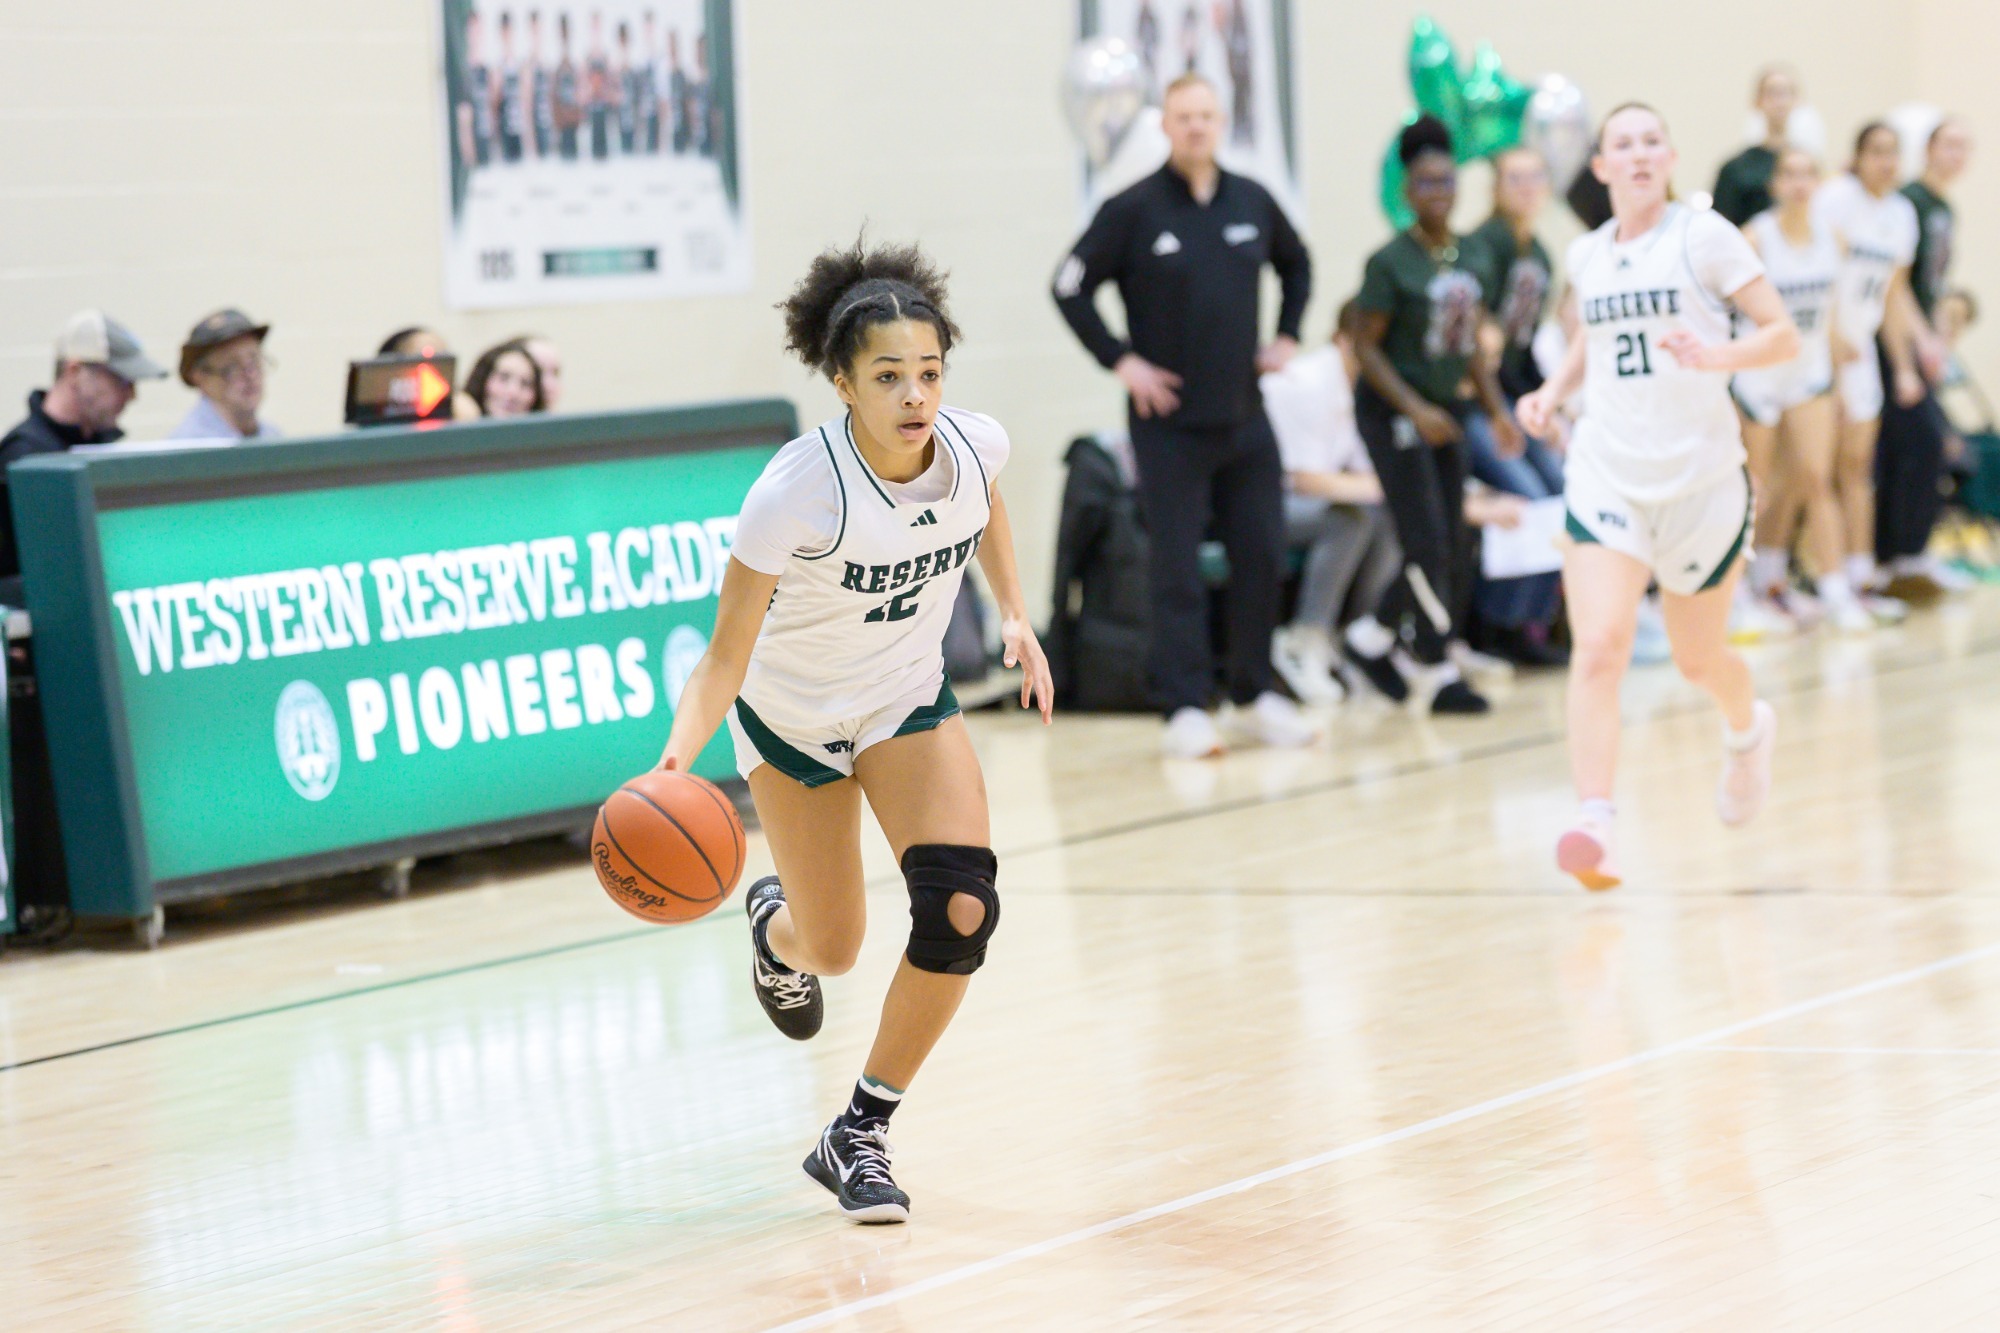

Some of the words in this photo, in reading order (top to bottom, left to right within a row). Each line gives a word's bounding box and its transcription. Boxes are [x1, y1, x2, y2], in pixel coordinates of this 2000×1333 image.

[1615, 331, 1653, 376] 21
[113, 562, 372, 676] WESTERN
[371, 534, 586, 641] RESERVE
[346, 637, 655, 762] PIONEERS
[594, 842, 668, 908] Rawlings
